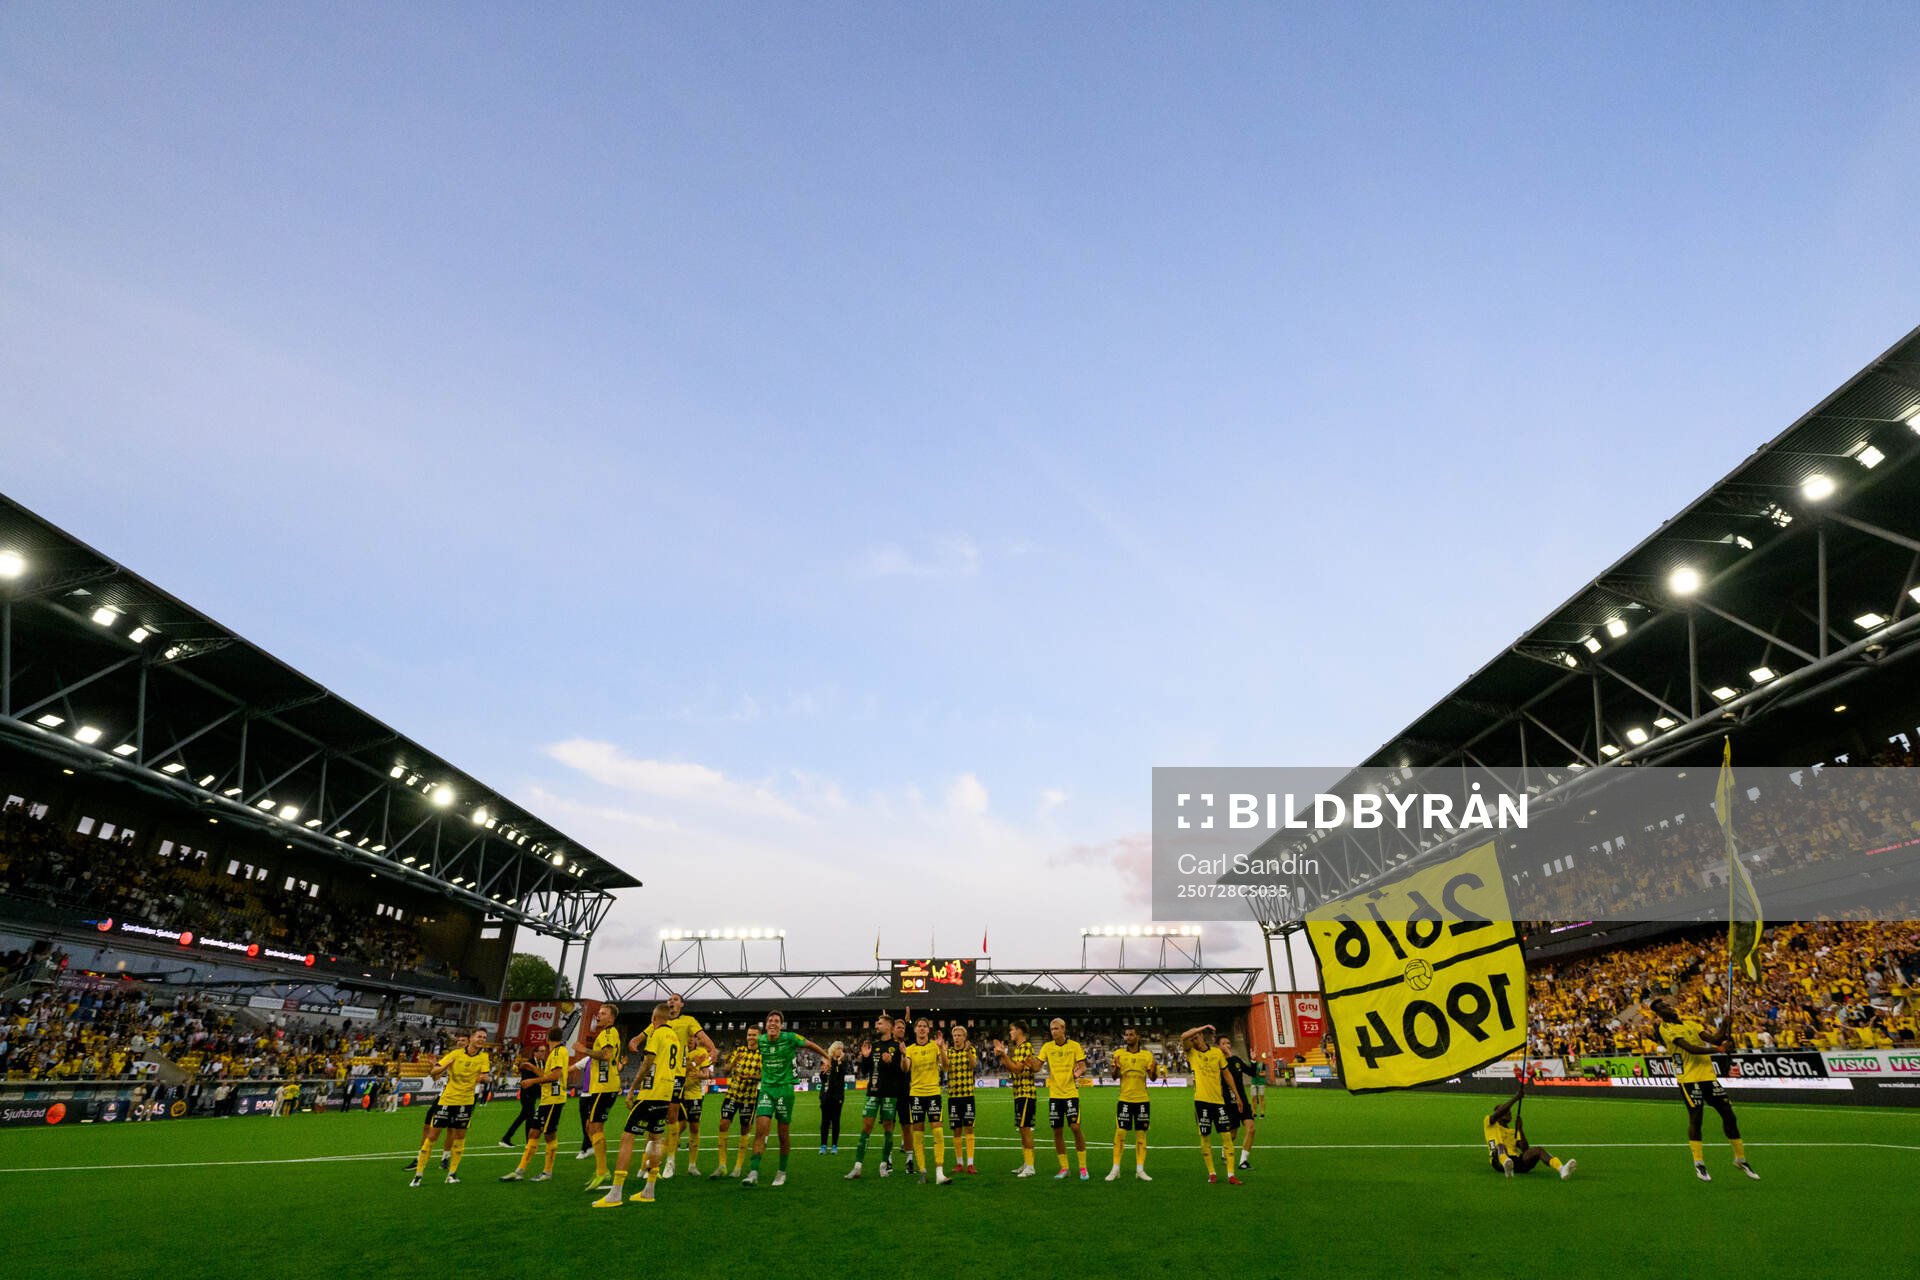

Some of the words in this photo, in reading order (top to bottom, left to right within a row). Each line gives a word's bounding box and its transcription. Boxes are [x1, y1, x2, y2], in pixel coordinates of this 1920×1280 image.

[669, 1043, 678, 1070] 8
[1732, 1057, 1777, 1076] Tech
[1776, 1056, 1818, 1076] Stn.
[1829, 1058, 1877, 1071] VISKO
